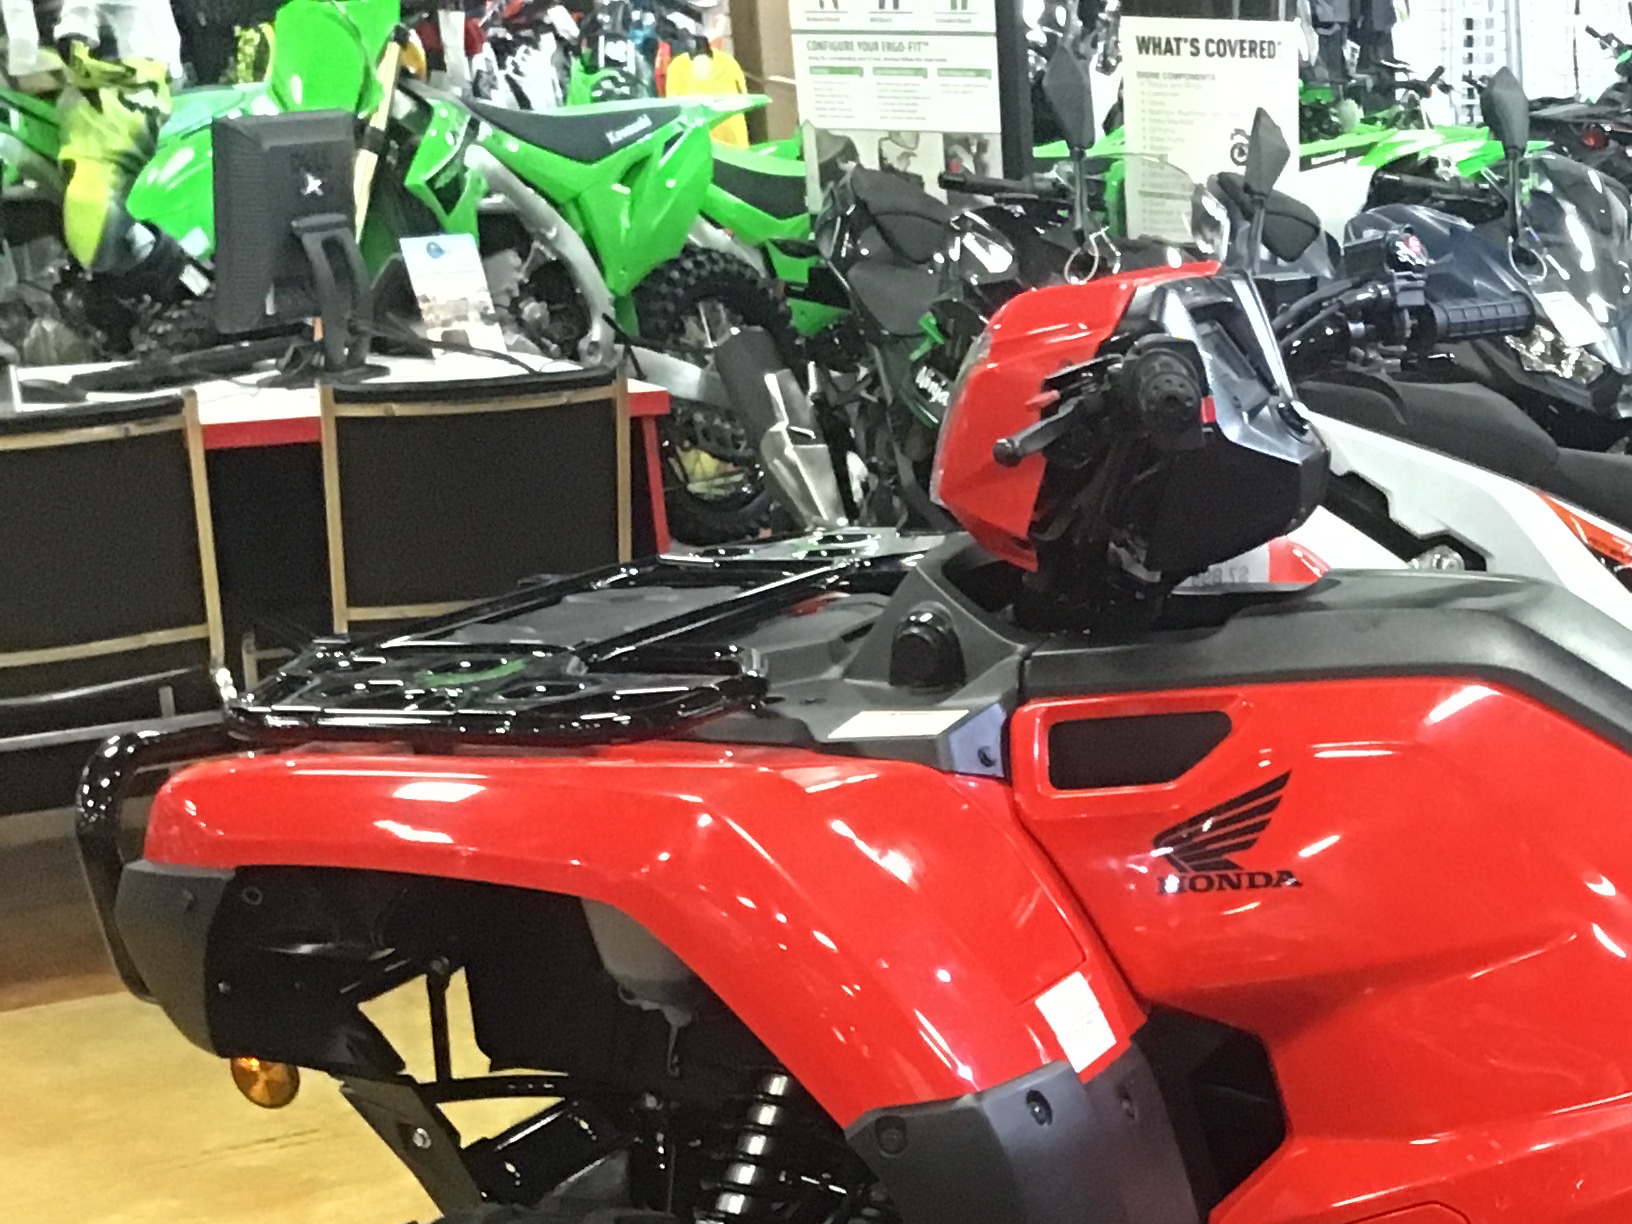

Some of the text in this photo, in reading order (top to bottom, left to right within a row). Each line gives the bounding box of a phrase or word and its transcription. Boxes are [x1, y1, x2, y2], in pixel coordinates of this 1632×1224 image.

[857, 41, 879, 53] YOUR
[1136, 35, 1200, 57] WHAT'S
[1157, 870, 1303, 895] HONDA
